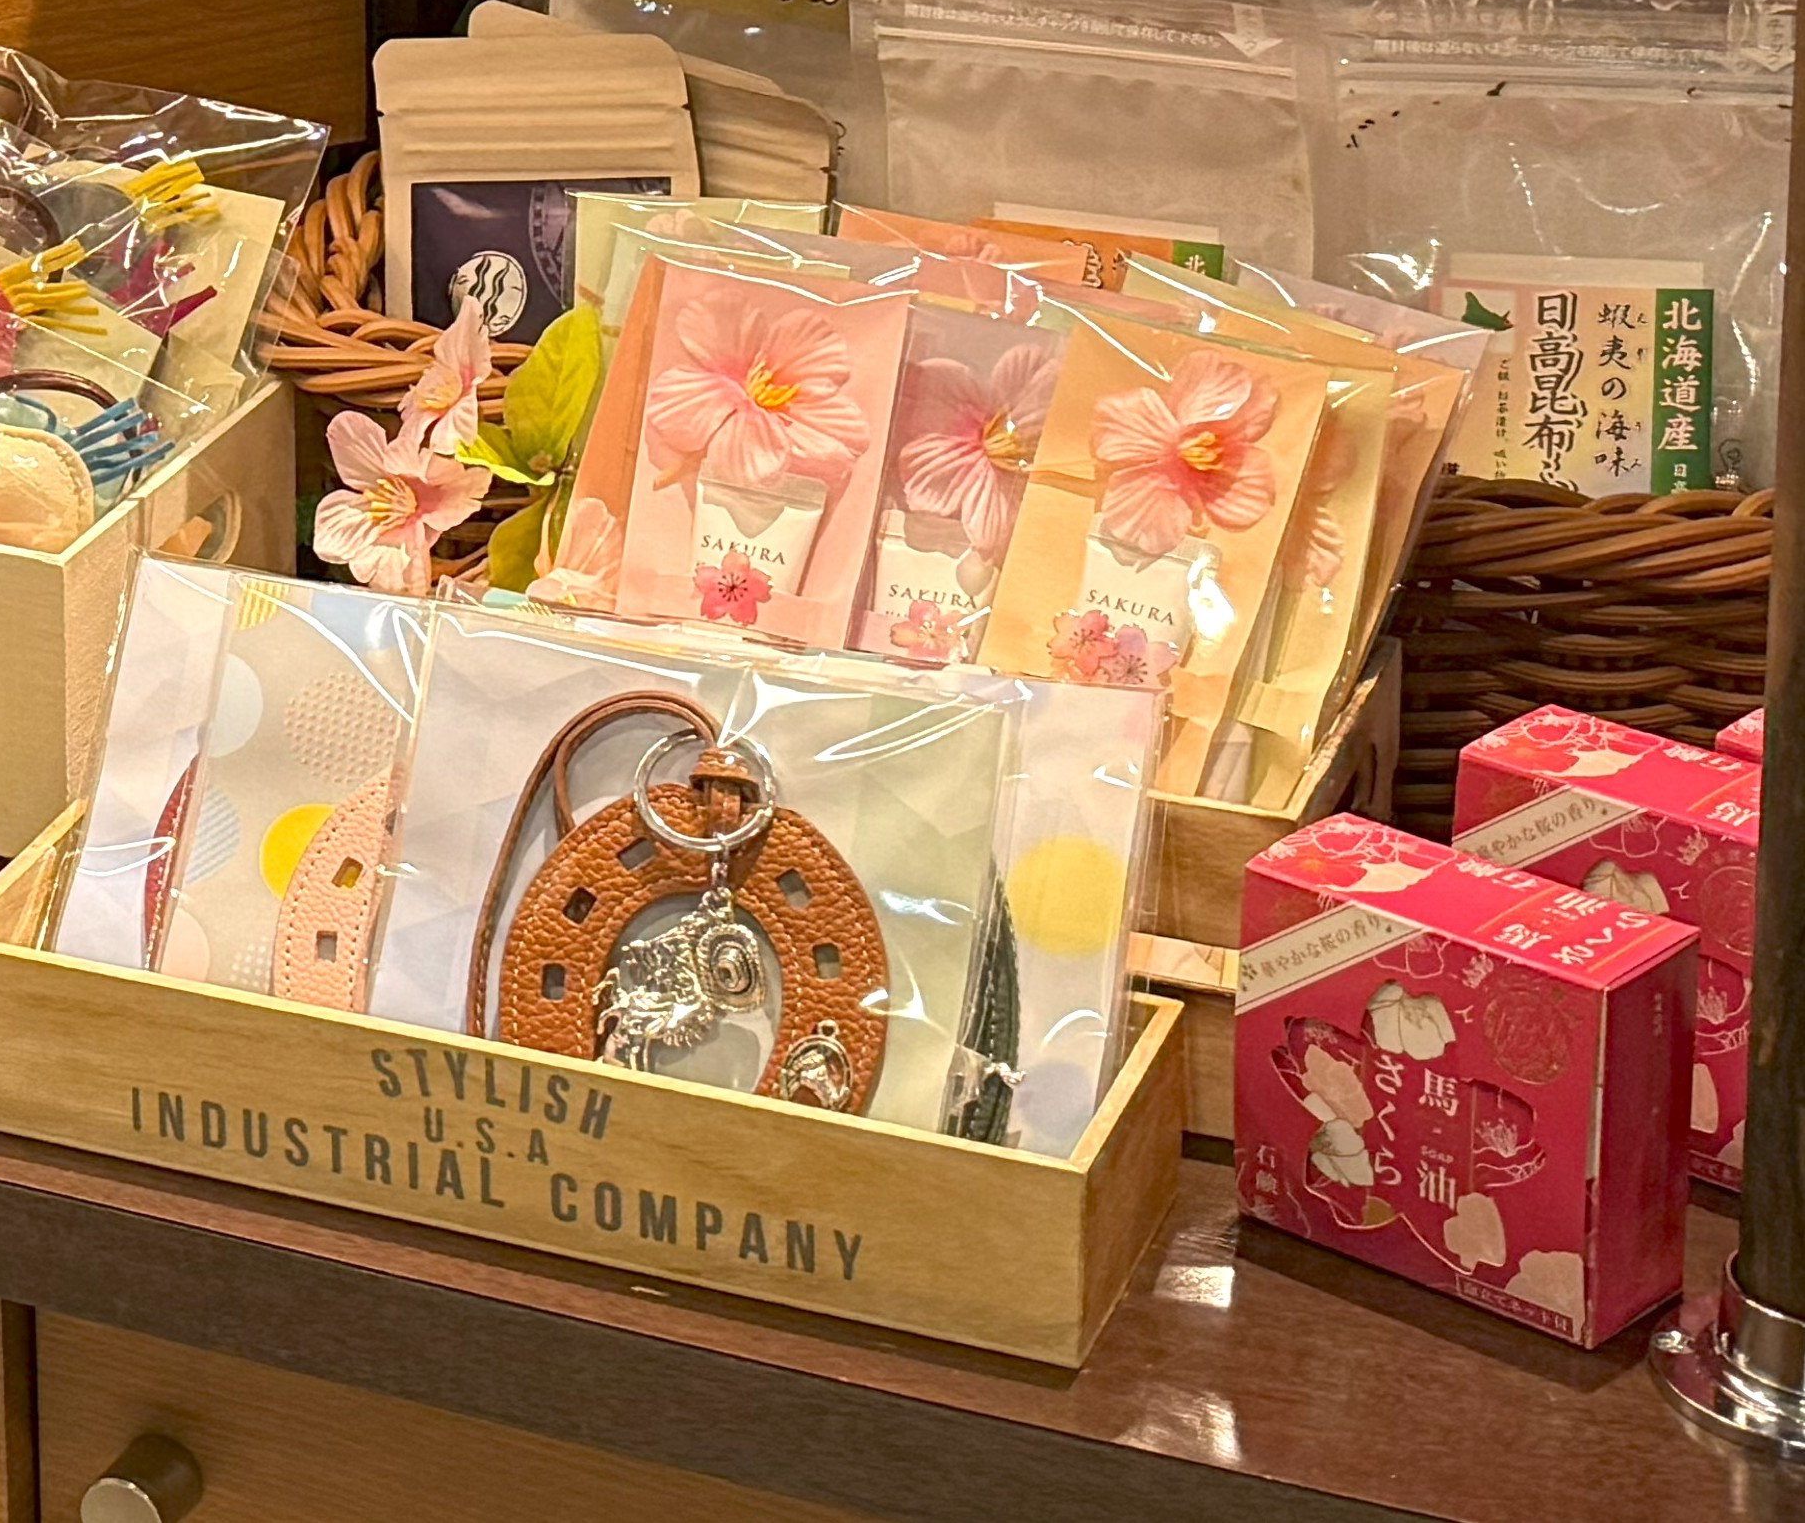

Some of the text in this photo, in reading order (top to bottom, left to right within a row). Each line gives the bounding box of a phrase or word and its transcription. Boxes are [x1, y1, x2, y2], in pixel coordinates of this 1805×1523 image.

[1593, 302, 1636, 478] 蝦夷の海味
[1656, 296, 1704, 452] 北海道産
[699, 533, 787, 566] SAKURA
[888, 583, 979, 610] SAKURA
[1088, 588, 1176, 627] SAKURA
[370, 1047, 613, 1141] STYLISH
[1371, 1054, 1406, 1188] さくら
[1418, 1067, 1460, 1118] 馬
[423, 1105, 550, 1166] U.S.A
[131, 1086, 865, 1281] INDUSTRIAL COMPANY
[1416, 1164, 1458, 1213] 油
